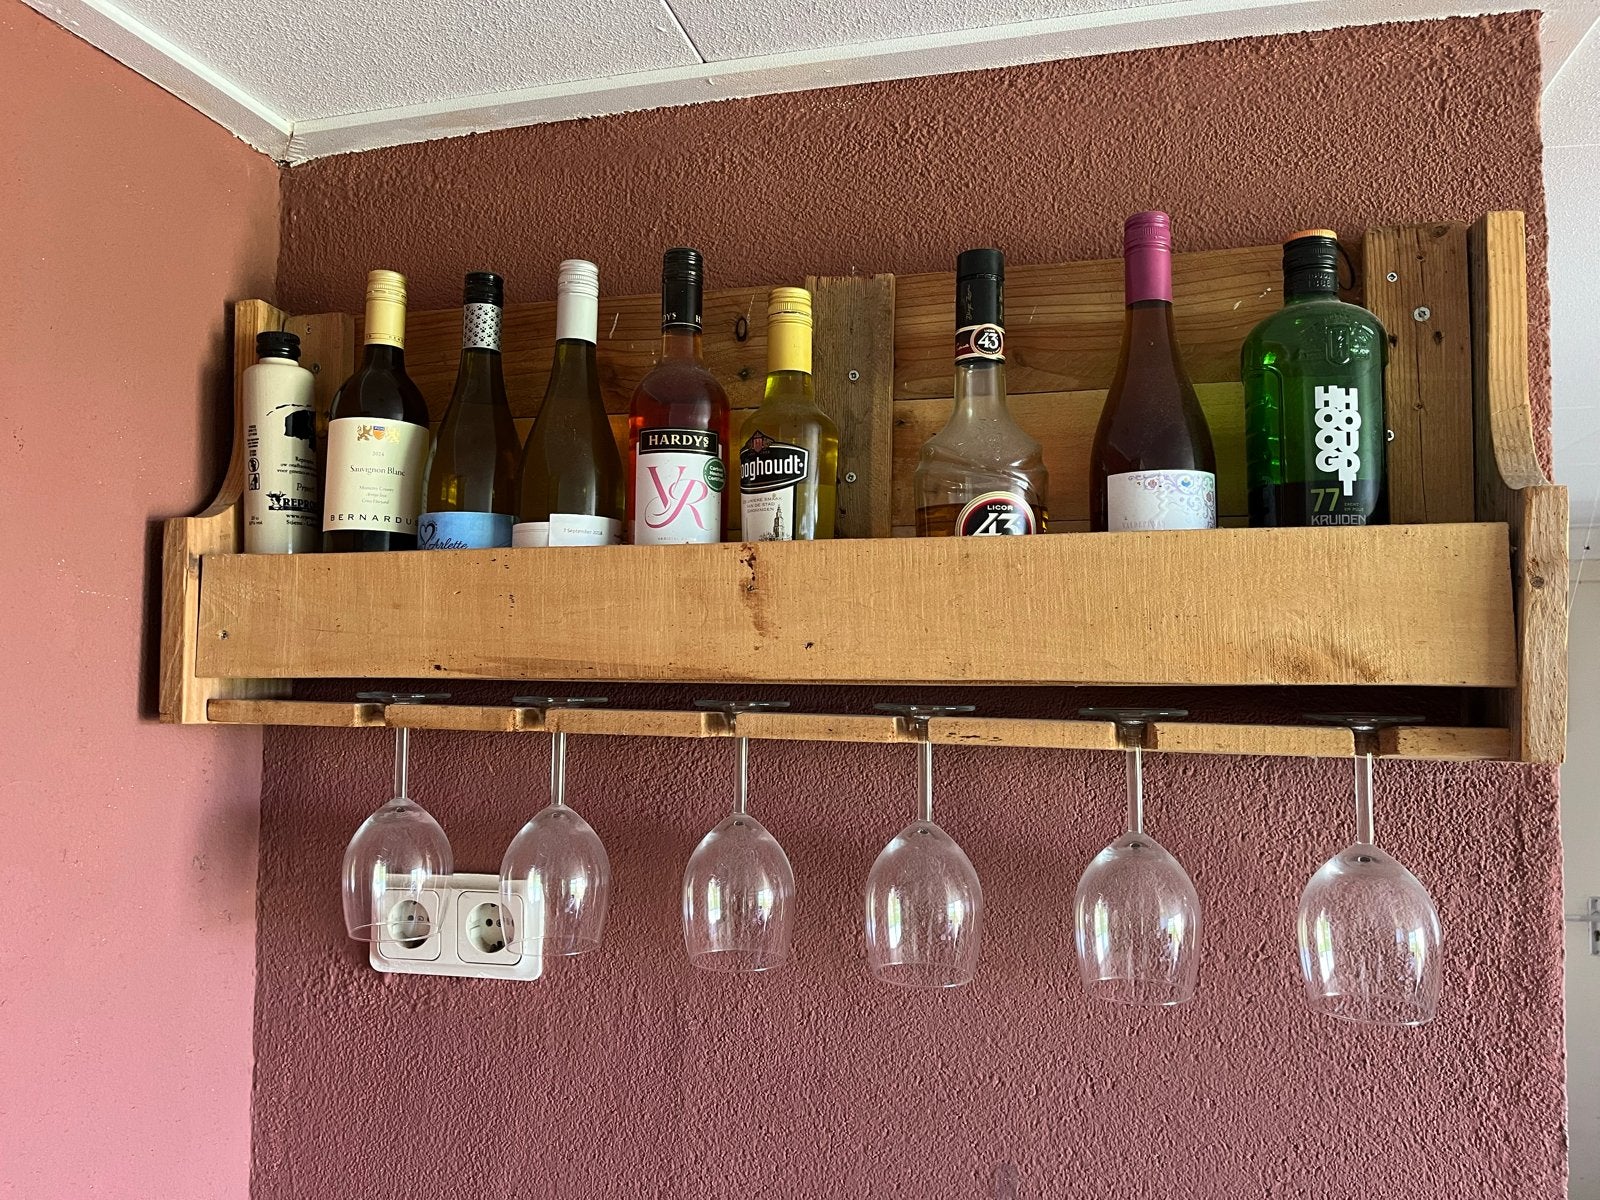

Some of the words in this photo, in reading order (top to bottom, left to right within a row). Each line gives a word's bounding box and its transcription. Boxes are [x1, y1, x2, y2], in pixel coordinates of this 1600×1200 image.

[977, 332, 999, 349] 43
[350, 465, 386, 475] Sauvignon
[387, 466, 406, 477] Blanc
[1310, 487, 1340, 512] 77
[1311, 514, 1367, 526] KRUIDEN
